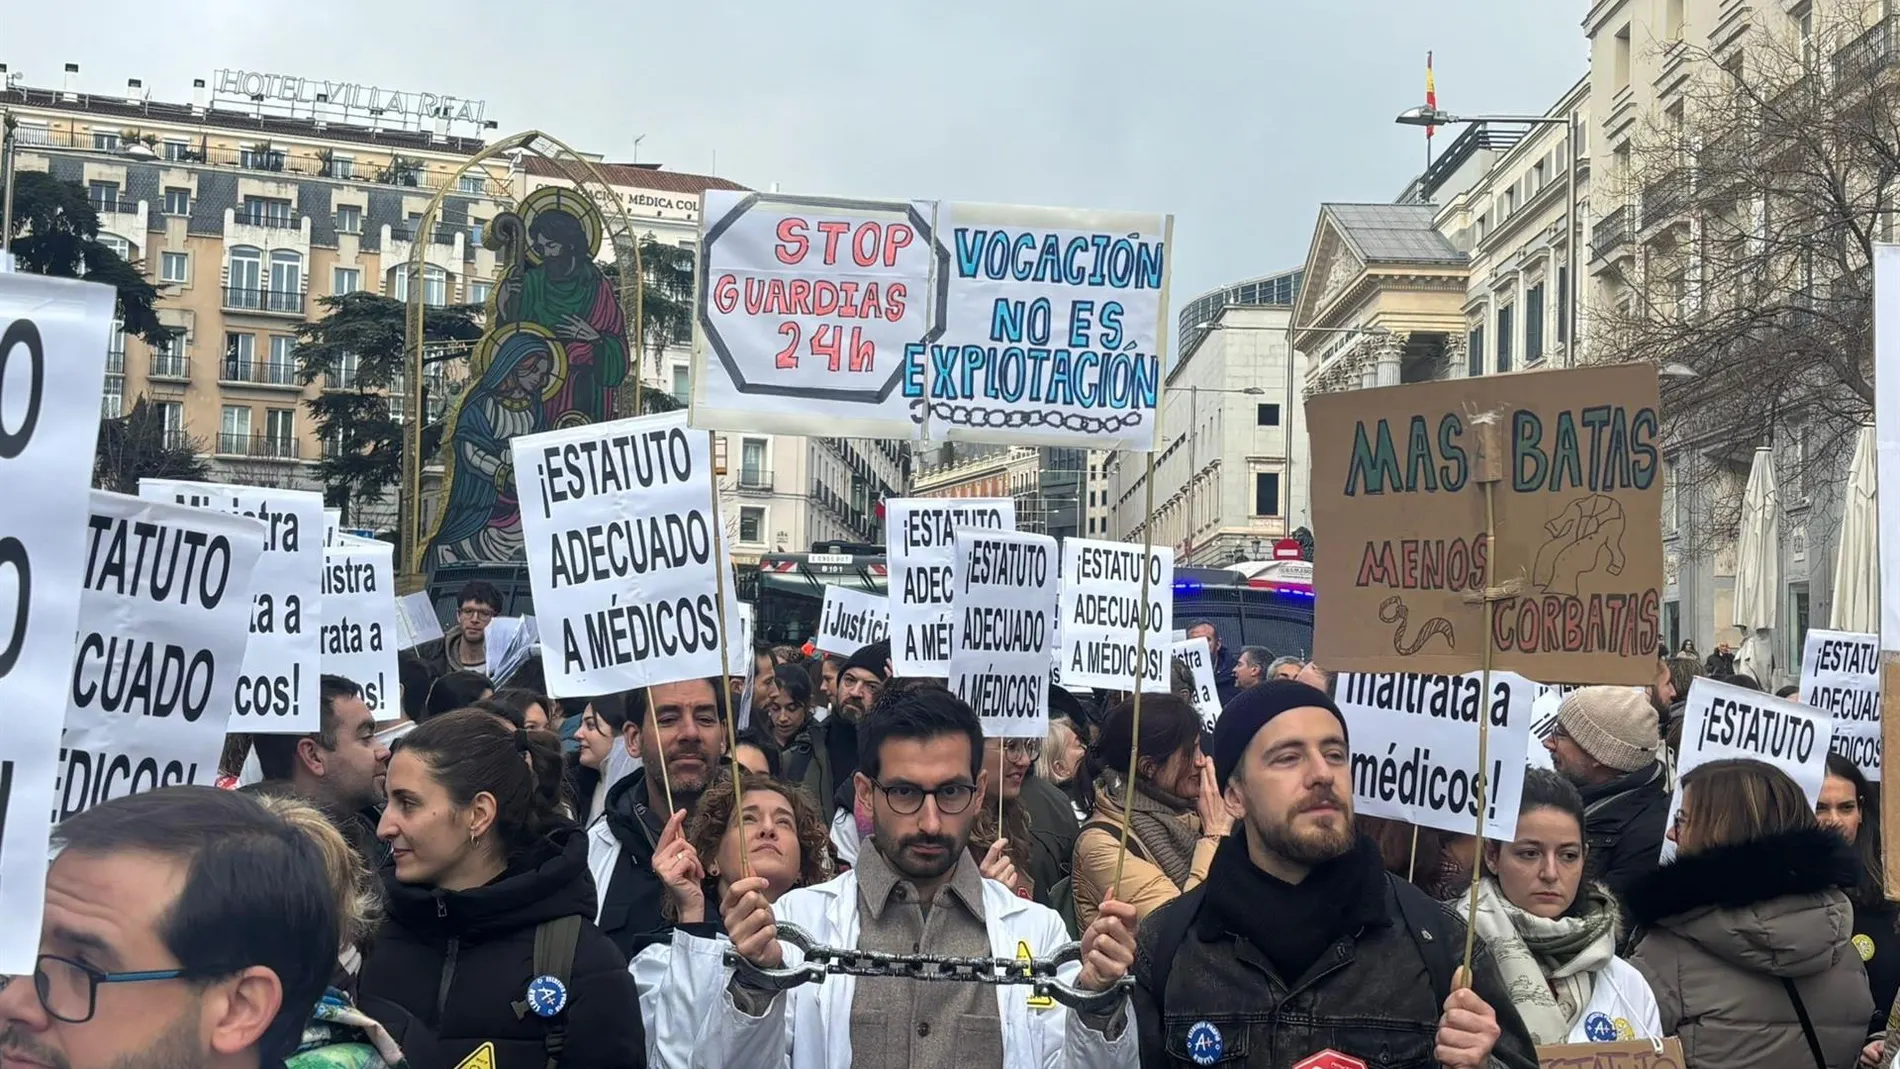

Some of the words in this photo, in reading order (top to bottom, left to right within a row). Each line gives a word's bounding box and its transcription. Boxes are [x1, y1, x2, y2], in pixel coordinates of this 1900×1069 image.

[219, 69, 310, 102] HOTEL
[324, 80, 404, 114] VILLA
[417, 92, 487, 124] REAL
[628, 193, 673, 209] MÉDICA
[676, 200, 699, 212] COL
[775, 217, 914, 268] STOP
[954, 228, 1164, 289] VOCACIÓN
[713, 274, 907, 323] GUARDIAS
[989, 297, 1052, 346] NO
[1068, 300, 1124, 351] ES
[775, 321, 876, 373] 24h
[902, 340, 1159, 409] EXPLOTACIÓN
[537, 427, 692, 519] ¡ESTATUTO
[1344, 413, 1469, 497] MAS
[1512, 405, 1658, 493] BATAS
[83, 514, 231, 610] TATUTO
[551, 509, 710, 589] ADECUADO
[965, 540, 1047, 594] ¡ESTATUTO
[1356, 532, 1489, 592] MENOS
[904, 565, 954, 605] ADEC
[284, 595, 301, 634] a
[369, 622, 383, 652] a
[962, 606, 1045, 653] ADECUADO
[1491, 588, 1659, 657] CORBATAS
[563, 617, 586, 675] A
[905, 624, 918, 662] A
[1071, 640, 1083, 673] A
[1087, 634, 1164, 682] MÉDICOS!
[1814, 640, 1879, 677] ¡ESTATU
[72, 632, 215, 723] CUADO
[234, 662, 301, 717] cos!
[971, 664, 1041, 718] MÉDICOS!
[1490, 681, 1511, 727] a
[1809, 686, 1880, 721] ADECUAD
[1697, 697, 1815, 764] ¡ESTATUTO
[1351, 742, 1502, 819] médicos!
